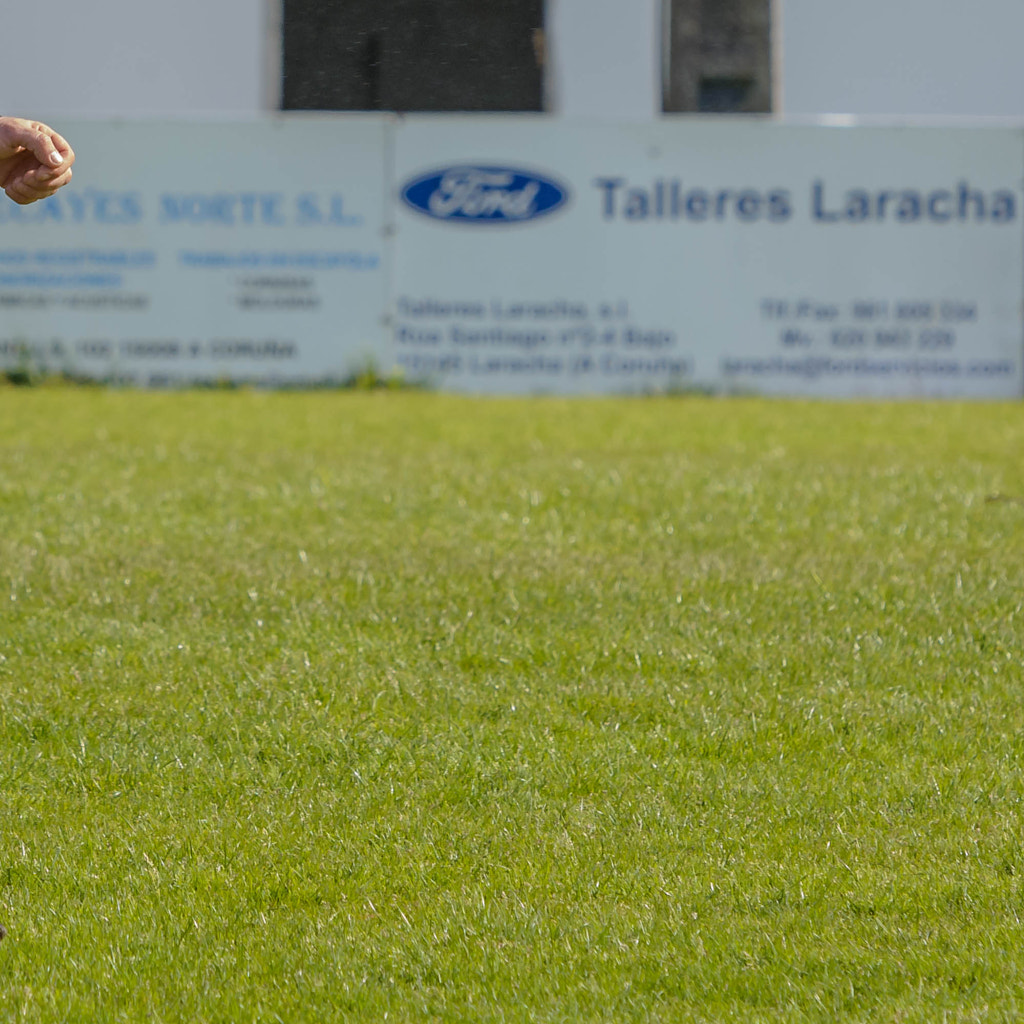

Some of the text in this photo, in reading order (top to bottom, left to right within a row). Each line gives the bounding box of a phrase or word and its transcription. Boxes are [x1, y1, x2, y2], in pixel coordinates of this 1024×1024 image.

[429, 166, 1017, 224] Ford Talleres Laracha
